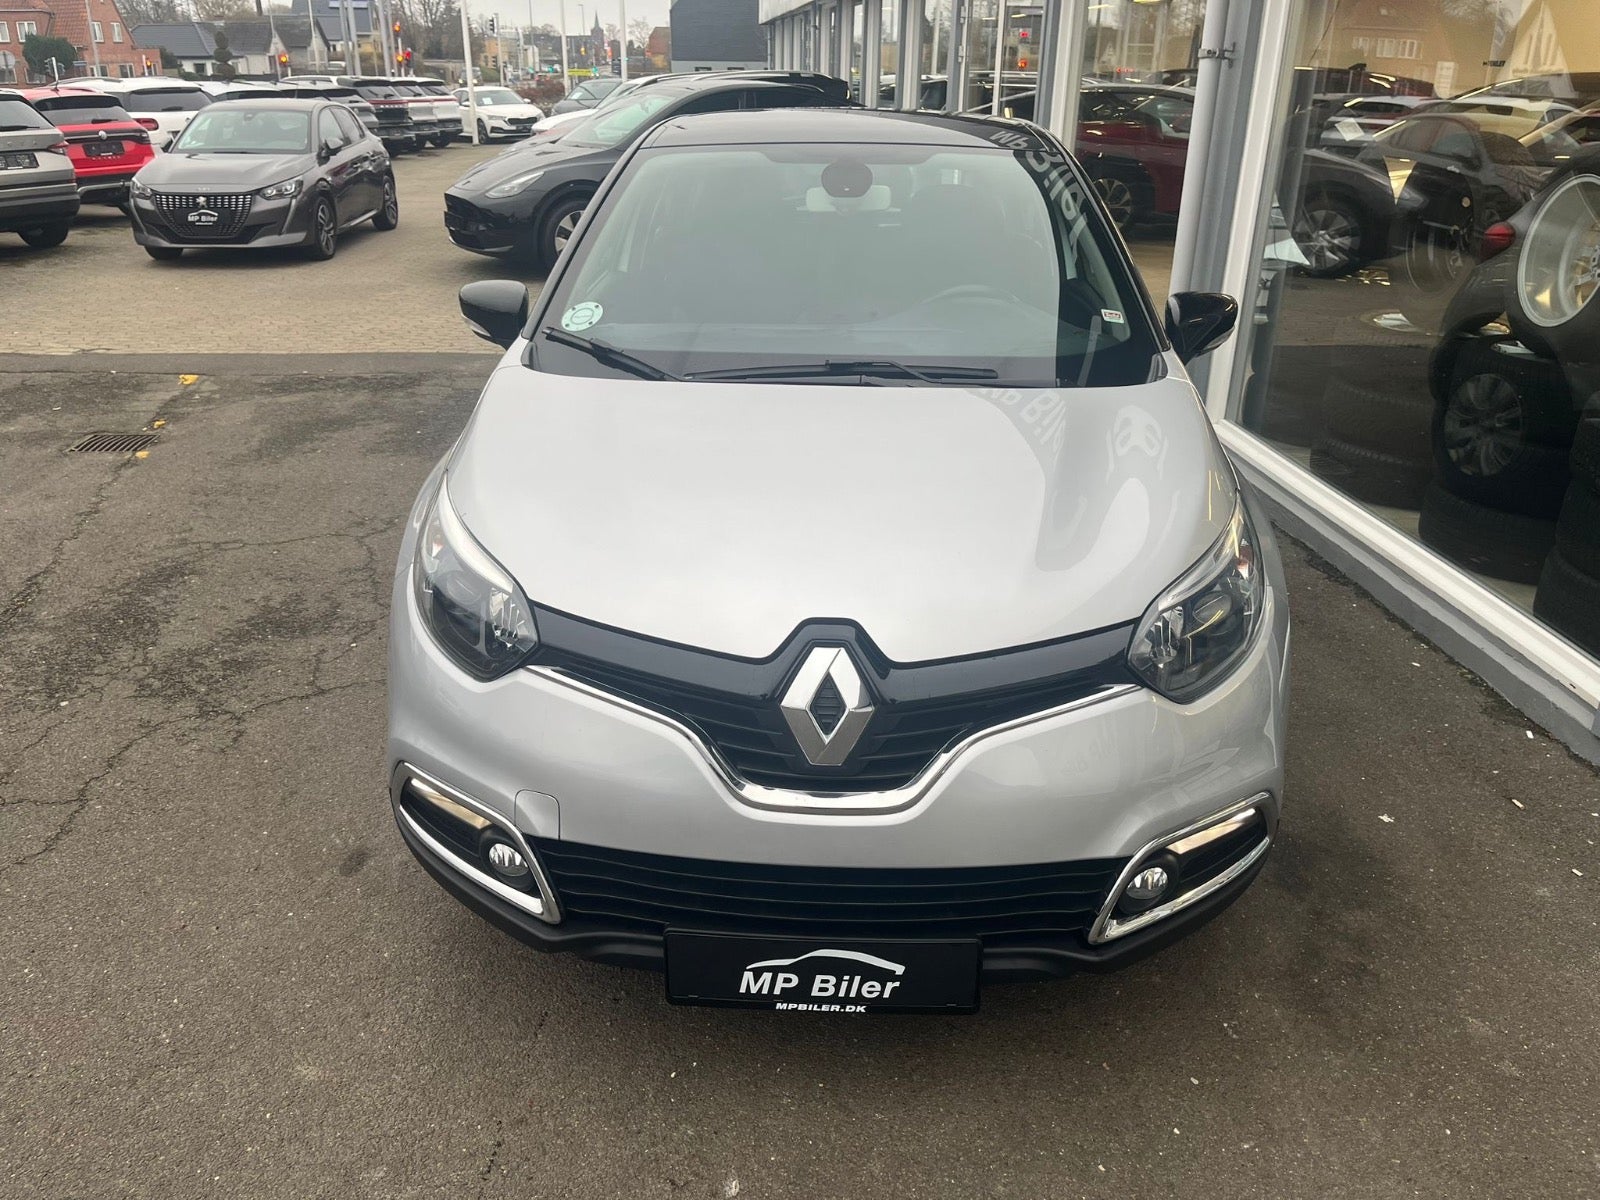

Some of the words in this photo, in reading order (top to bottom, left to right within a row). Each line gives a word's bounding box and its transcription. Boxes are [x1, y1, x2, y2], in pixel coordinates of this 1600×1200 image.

[739, 971, 799, 995] MP
[810, 974, 900, 999] Biler
[775, 1003, 867, 1013] MPBILER.DK
